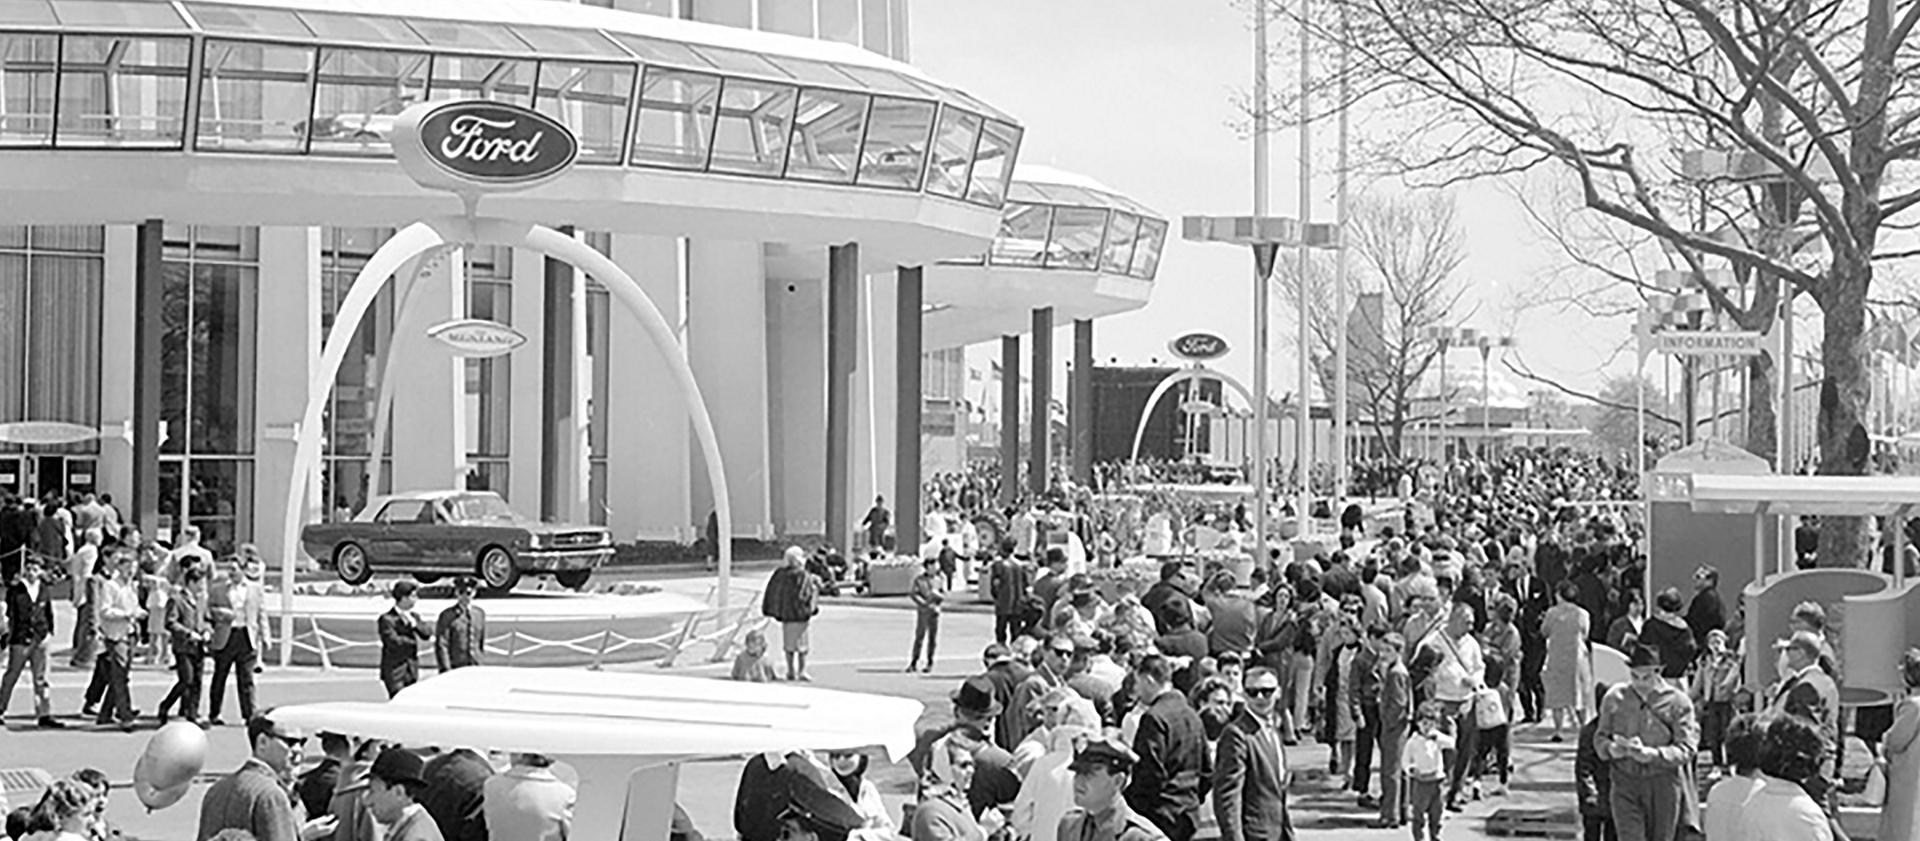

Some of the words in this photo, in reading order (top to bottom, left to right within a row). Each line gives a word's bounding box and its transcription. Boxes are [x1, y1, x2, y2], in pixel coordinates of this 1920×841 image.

[441, 114, 543, 162] Ford
[1182, 337, 1217, 353] Ford
[1662, 336, 1755, 348] INFORMATION
